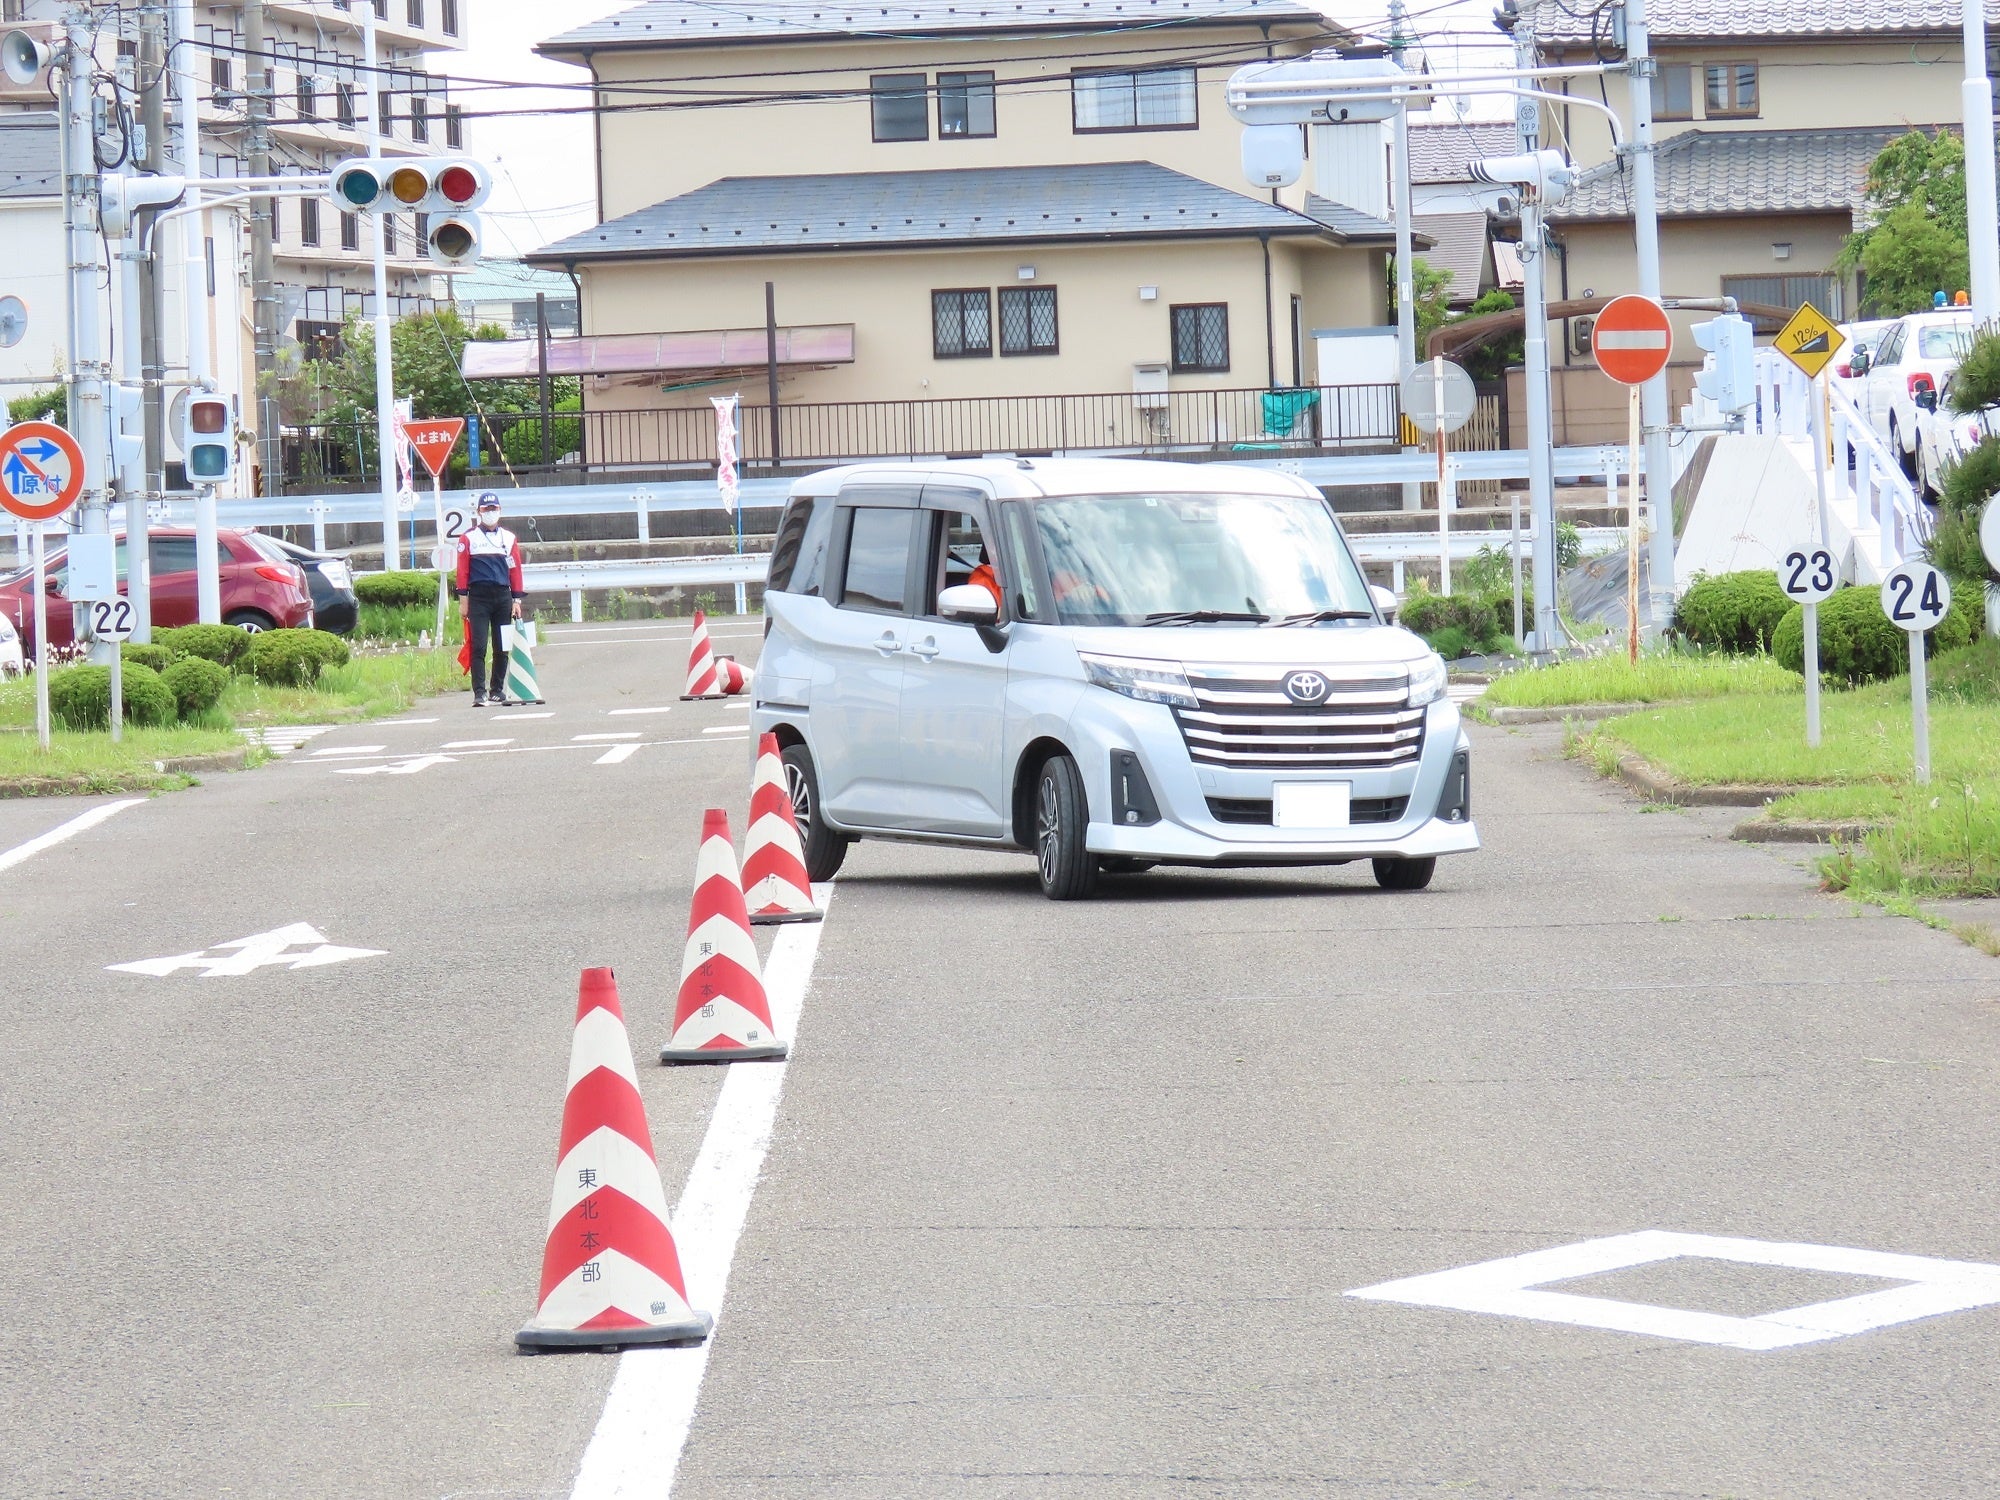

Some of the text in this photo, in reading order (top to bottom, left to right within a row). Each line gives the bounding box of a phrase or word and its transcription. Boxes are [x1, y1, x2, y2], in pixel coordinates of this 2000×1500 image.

[1793, 324, 1818, 345] 12%
[415, 430, 453, 445] 止まれ
[22, 474, 62, 494] 原付
[1786, 551, 1833, 593] 23
[1890, 570, 1943, 621] 24
[95, 601, 131, 634] 22
[699, 942, 715, 1018] 東北本部
[578, 1168, 601, 1283] 東北本部
